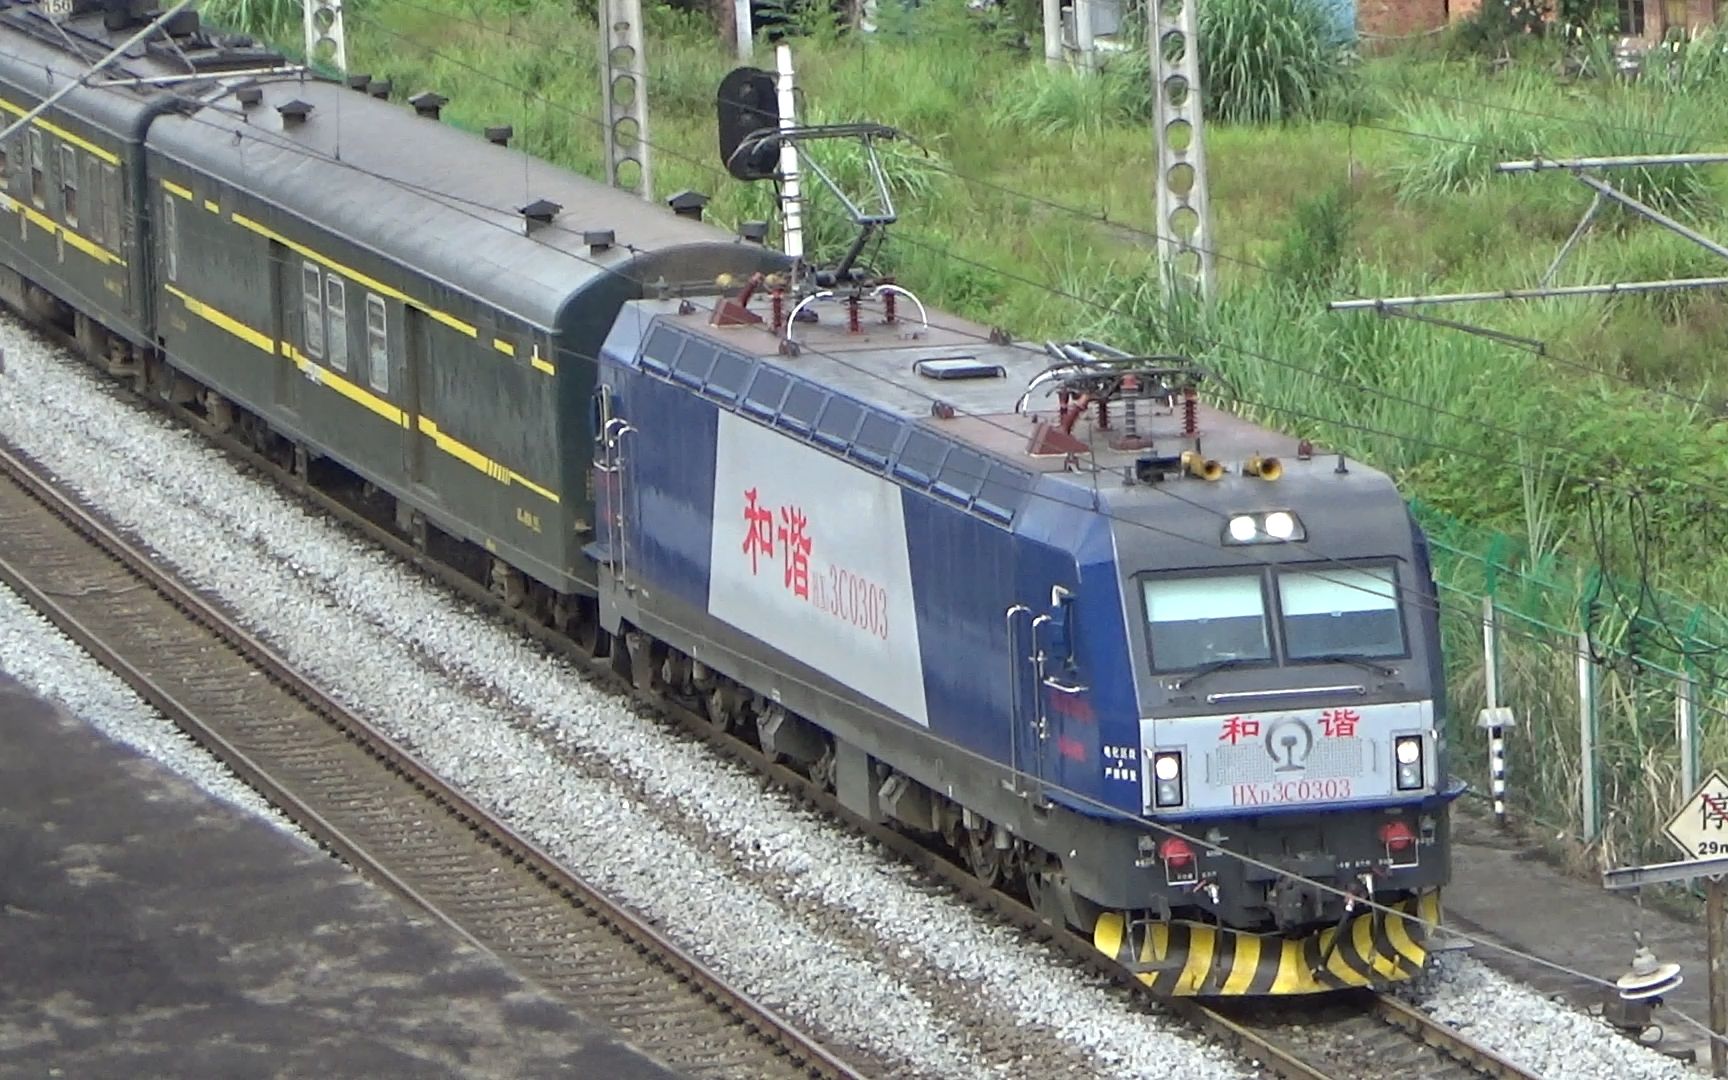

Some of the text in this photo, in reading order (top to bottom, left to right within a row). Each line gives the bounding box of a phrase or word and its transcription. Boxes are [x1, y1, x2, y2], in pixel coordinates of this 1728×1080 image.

[742, 487, 812, 601] 和谐
[1219, 709, 1360, 745] 和 谐
